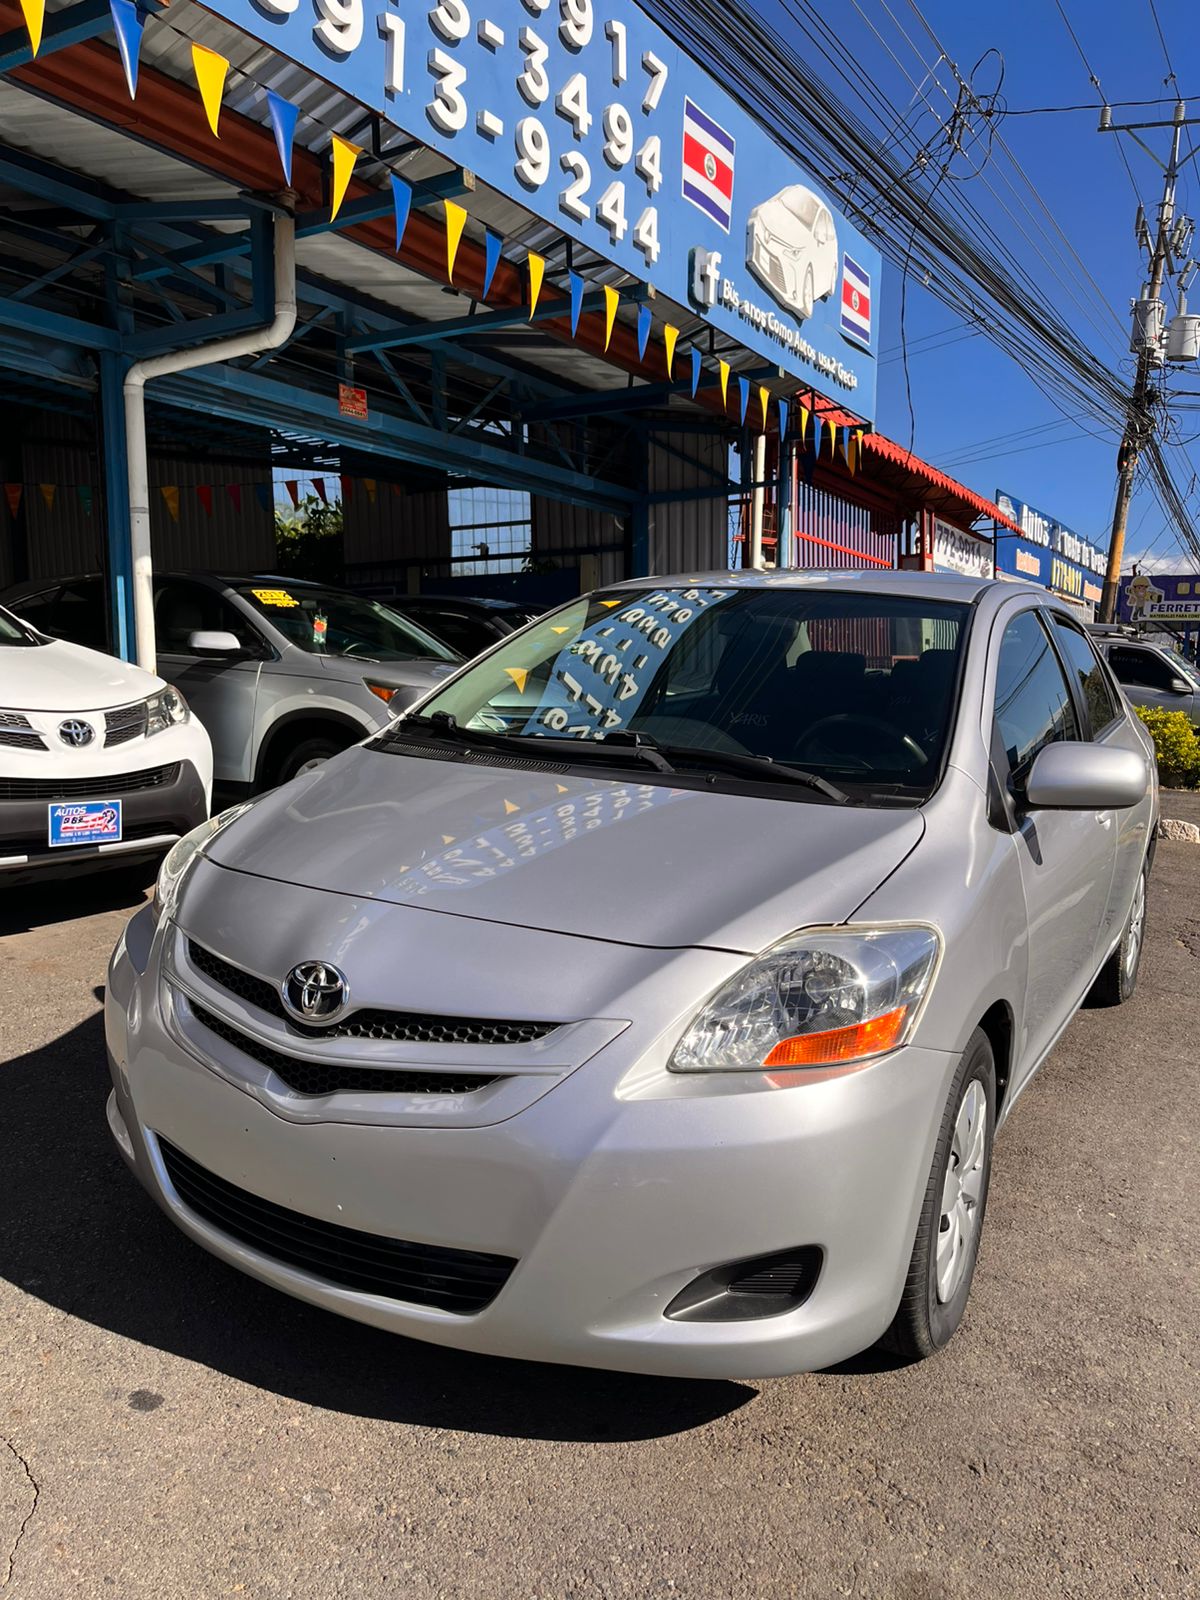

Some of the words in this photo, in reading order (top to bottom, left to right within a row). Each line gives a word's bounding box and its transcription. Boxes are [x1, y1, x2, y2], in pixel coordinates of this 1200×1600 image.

[260, 0, 660, 264] 913-9244
[767, 312, 793, 343] Como
[793, 331, 816, 361] Autos
[1150, 603, 1200, 613] FERRET
[54, 806, 87, 817] AUTOS
